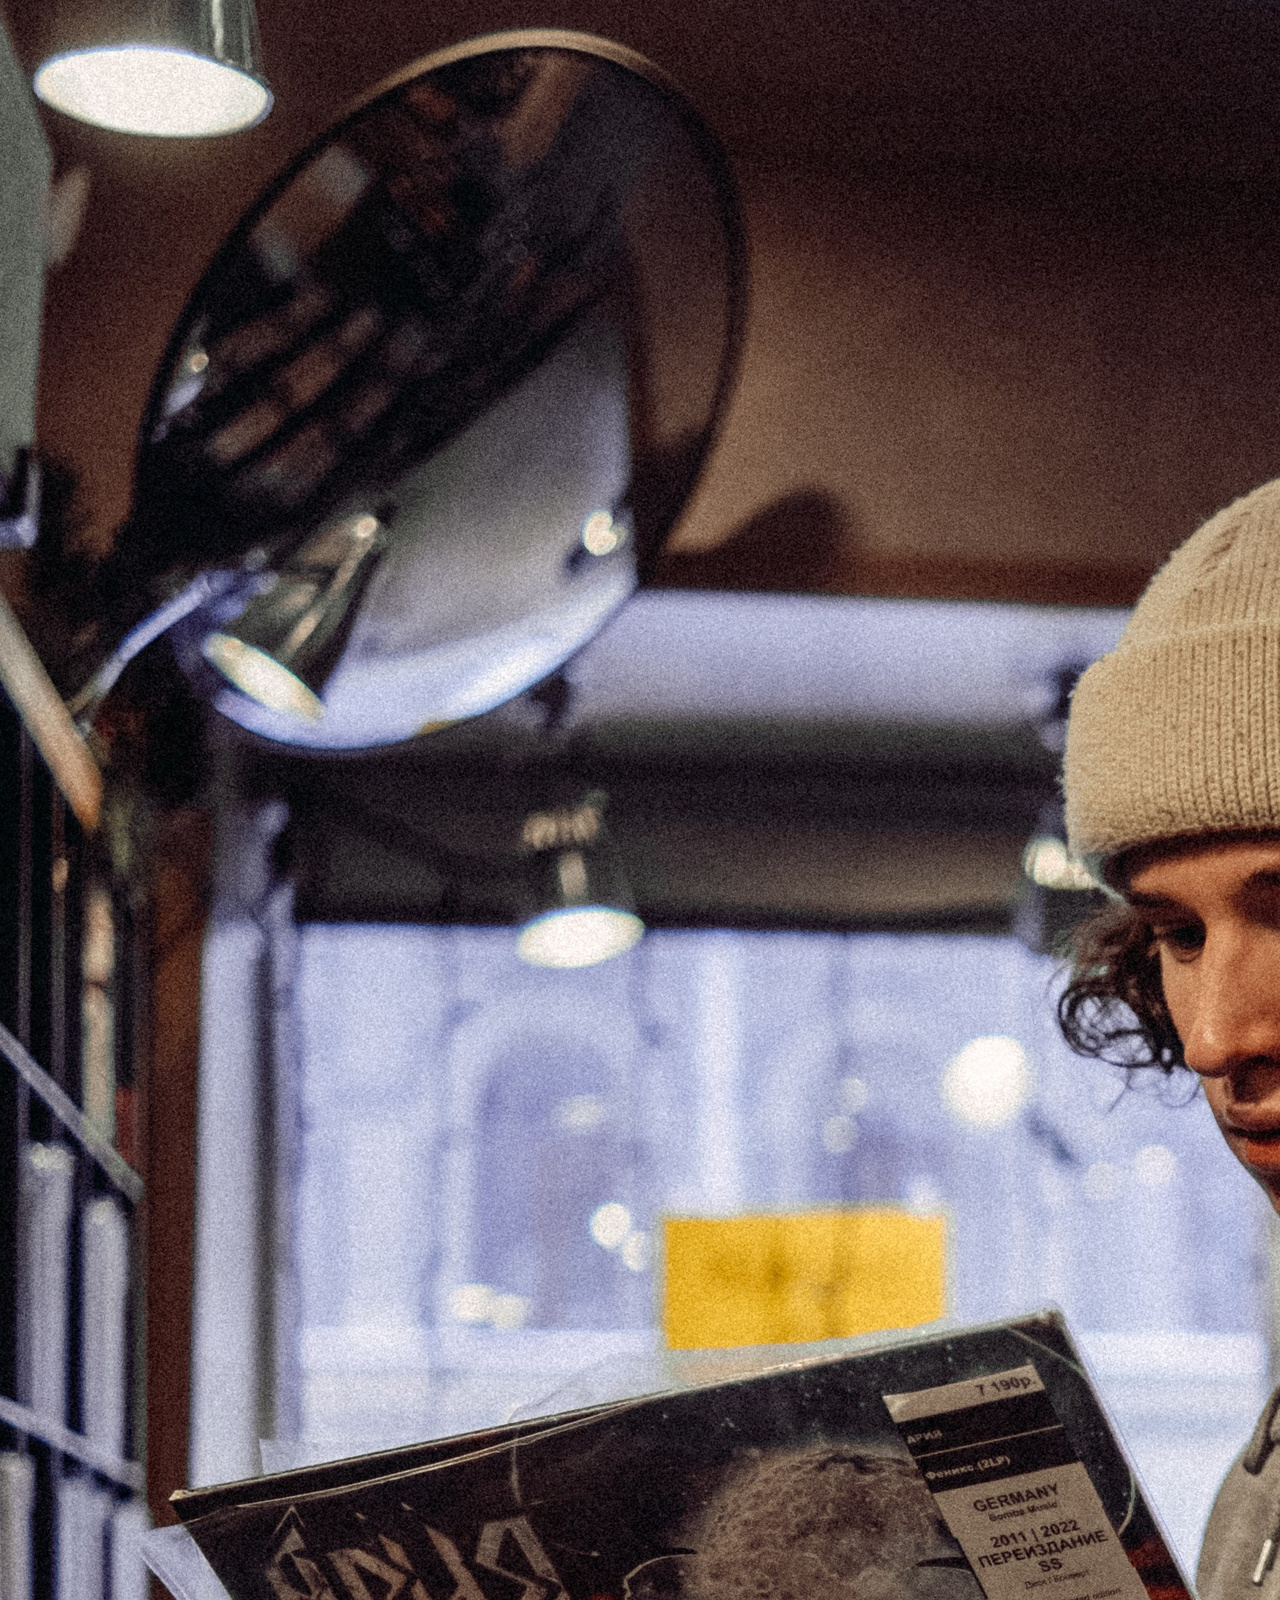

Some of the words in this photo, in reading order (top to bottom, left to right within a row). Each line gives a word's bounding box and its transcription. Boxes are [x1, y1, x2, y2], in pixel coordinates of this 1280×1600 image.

[975, 1383, 986, 1397] 7
[906, 1428, 943, 1444] АРИЯ
[925, 1463, 975, 1481] Феникс
[976, 1455, 1011, 1472] (2LP)
[972, 1482, 1059, 1514] GERMANY
[990, 1531, 1028, 1549] 2011
[1040, 1519, 1081, 1538] 2022
[978, 1529, 1109, 1568] ПЕРЕИЗДАНИЕ
[1038, 1557, 1064, 1573] SS
